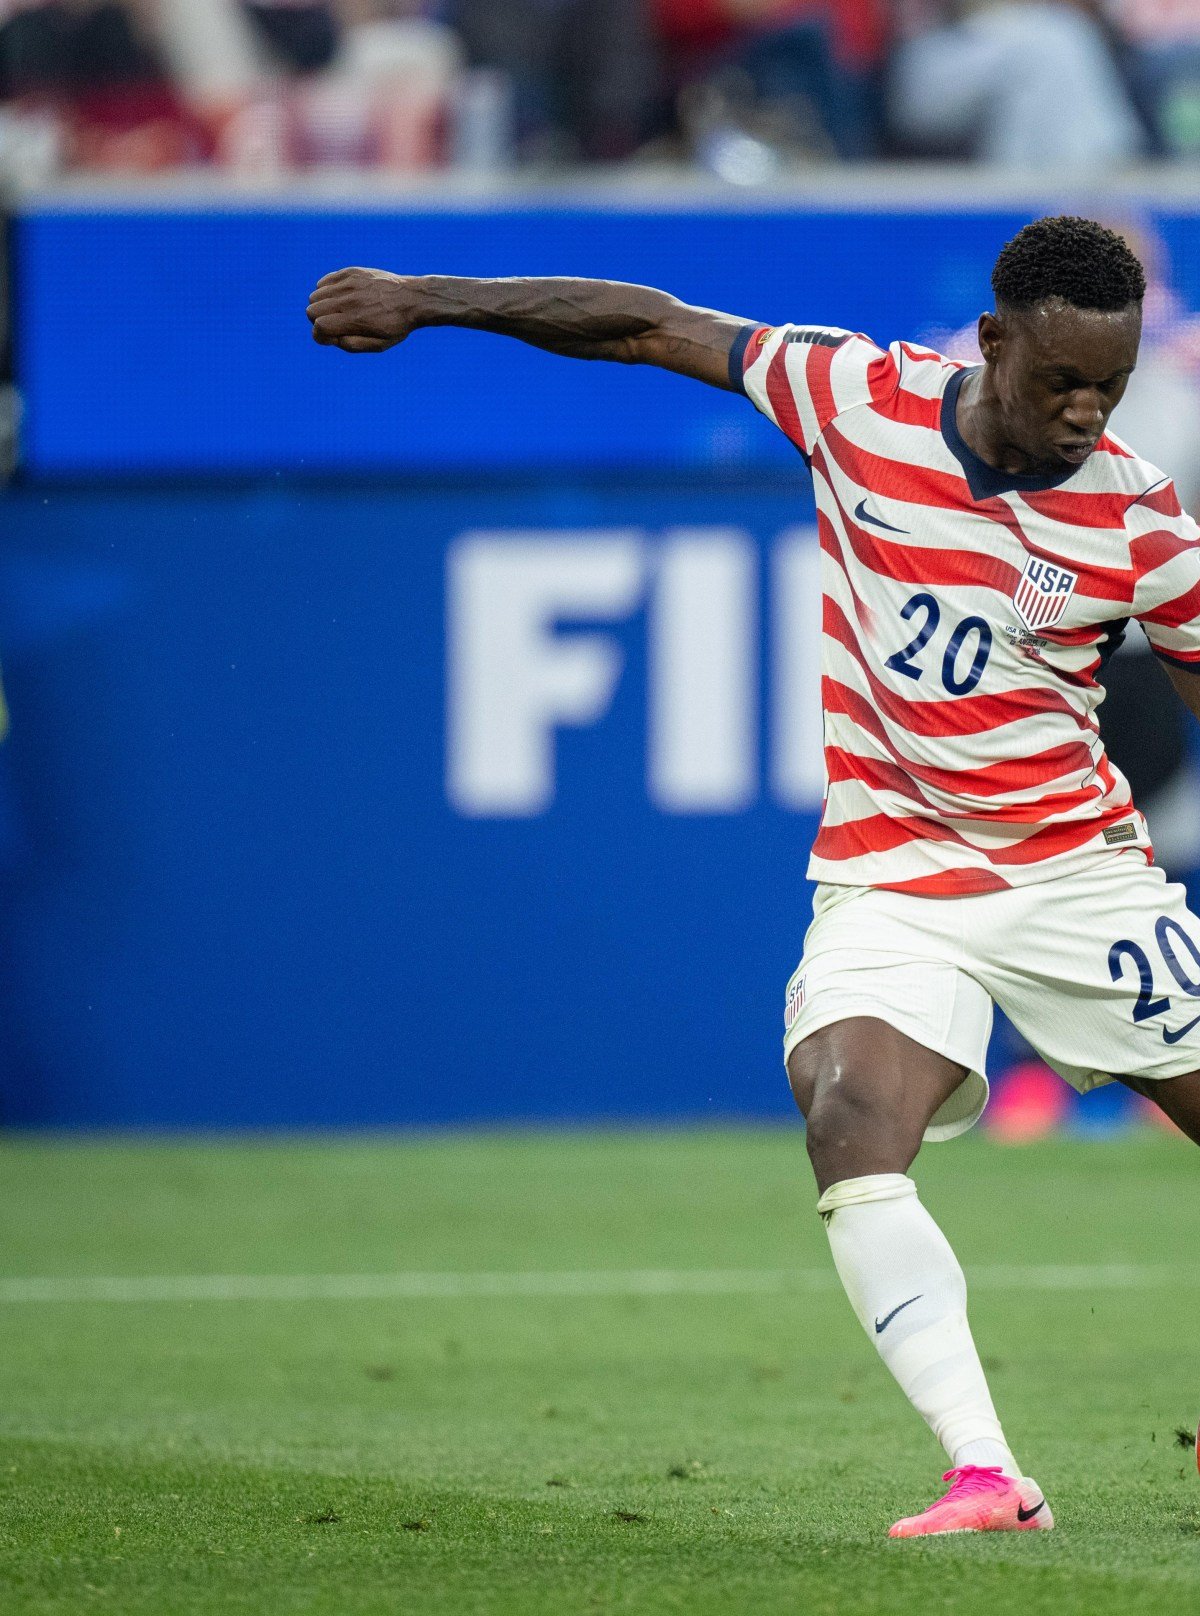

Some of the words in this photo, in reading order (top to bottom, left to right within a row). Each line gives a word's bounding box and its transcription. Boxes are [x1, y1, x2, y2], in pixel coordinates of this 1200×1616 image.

[1027, 560, 1073, 593] USA
[884, 593, 993, 696] 20
[787, 979, 803, 1006] SA
